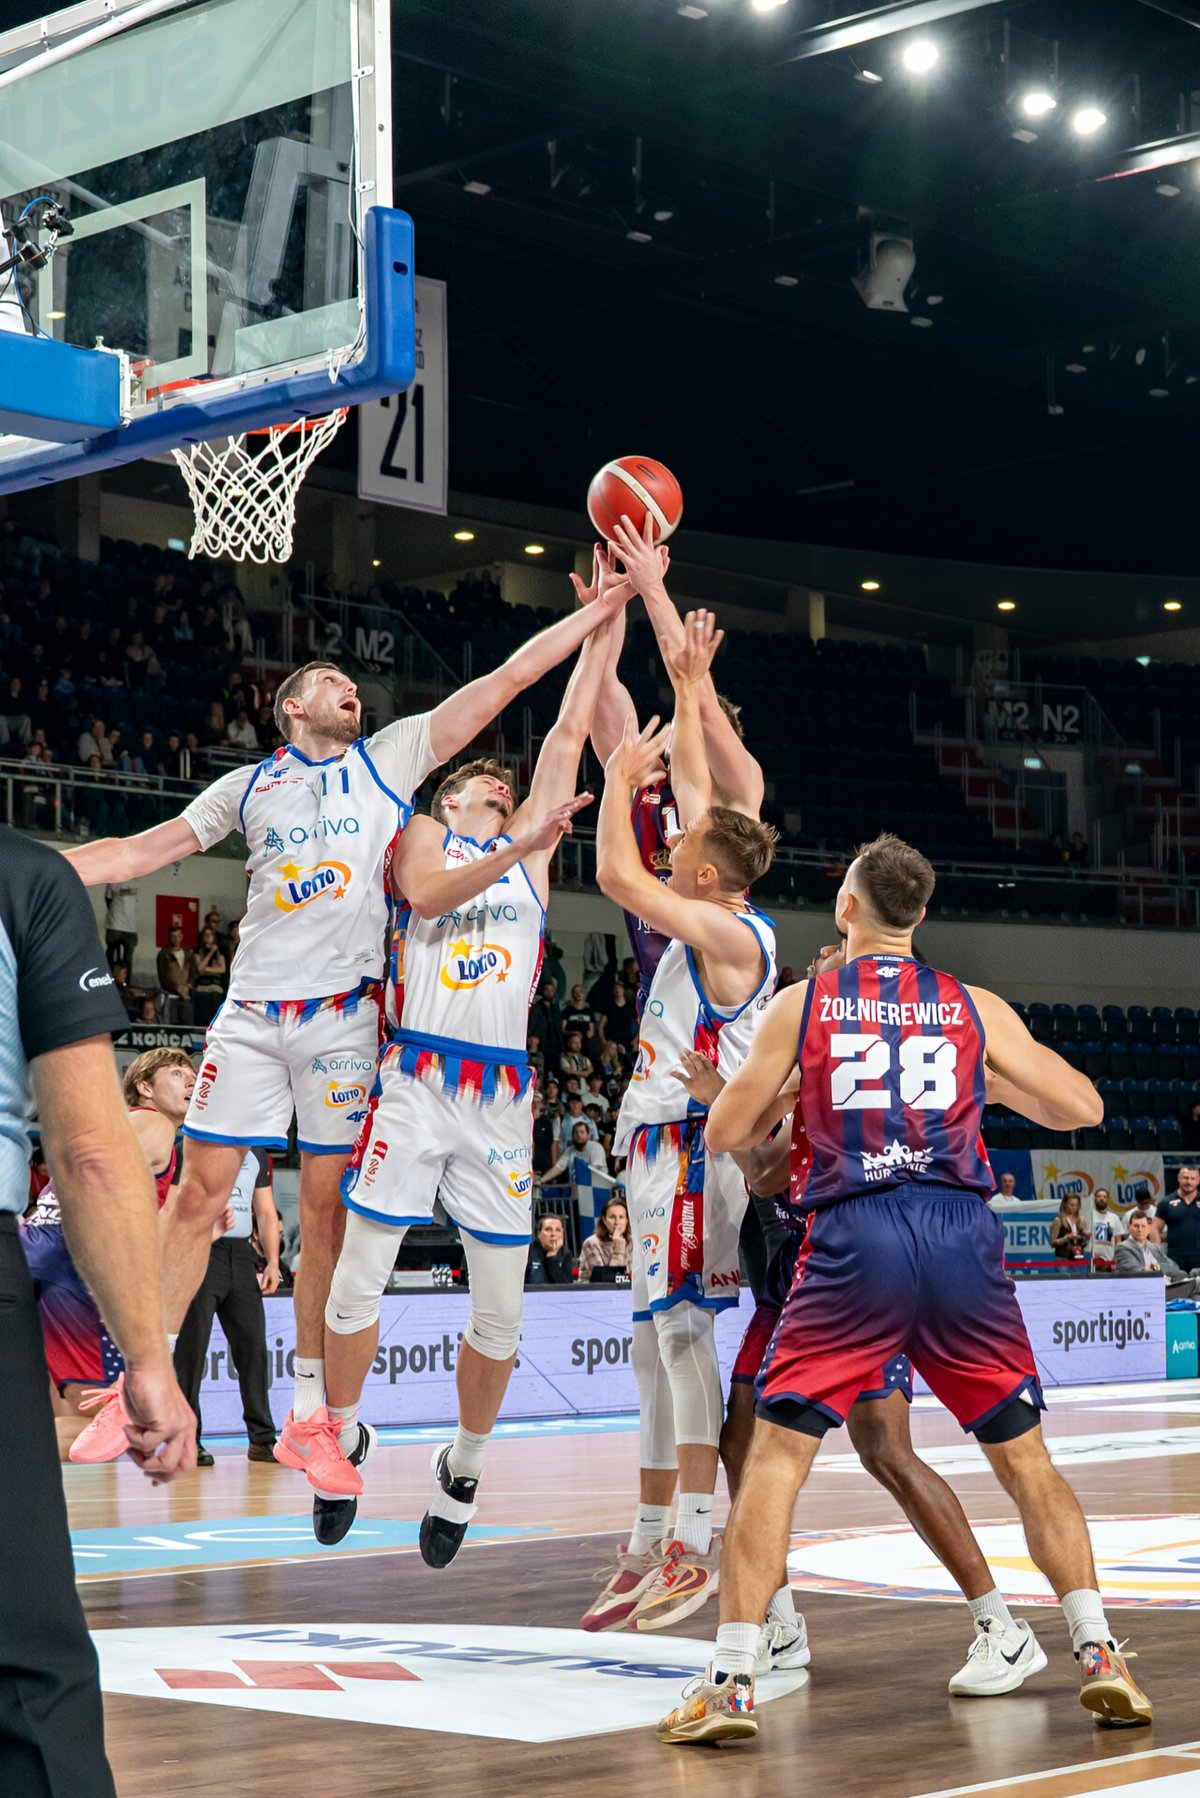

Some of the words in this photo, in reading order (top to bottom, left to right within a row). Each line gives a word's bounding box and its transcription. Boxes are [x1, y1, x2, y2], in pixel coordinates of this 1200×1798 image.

[355, 627, 395, 664] M2
[1042, 704, 1080, 734] N2
[875, 966, 902, 978] 4F
[819, 994, 964, 1026] ŻOŁNIEREWICZ
[131, 1029, 193, 1048] KOŃCA
[329, 1059, 372, 1071] arriva
[830, 1033, 958, 1111] 28
[571, 1336, 633, 1376] spor
